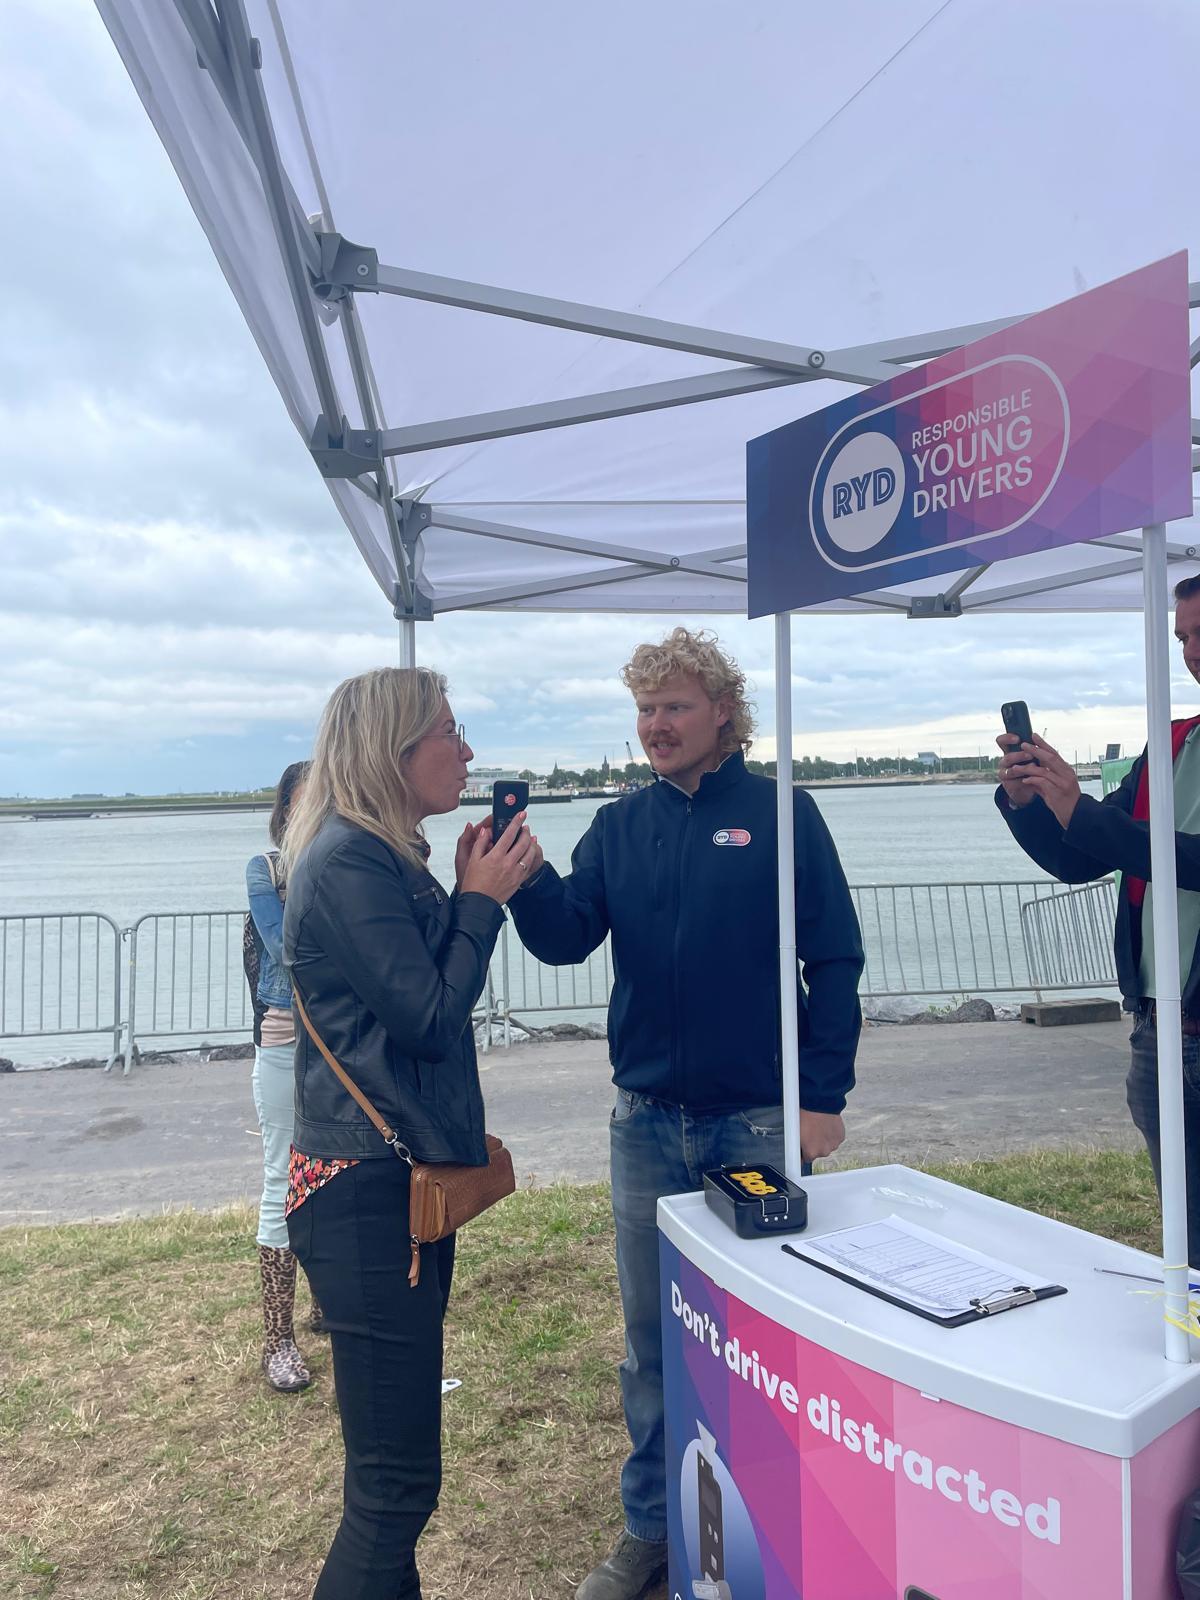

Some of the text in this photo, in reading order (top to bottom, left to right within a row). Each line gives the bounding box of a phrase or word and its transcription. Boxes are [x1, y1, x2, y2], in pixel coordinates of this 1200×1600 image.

[912, 389, 1032, 449] RESPONSIBLE
[912, 415, 1033, 483] YOUNG
[832, 467, 896, 519] RYD
[913, 454, 1033, 519] DRIVERS
[671, 1280, 1061, 1545] Don't drive distracted
